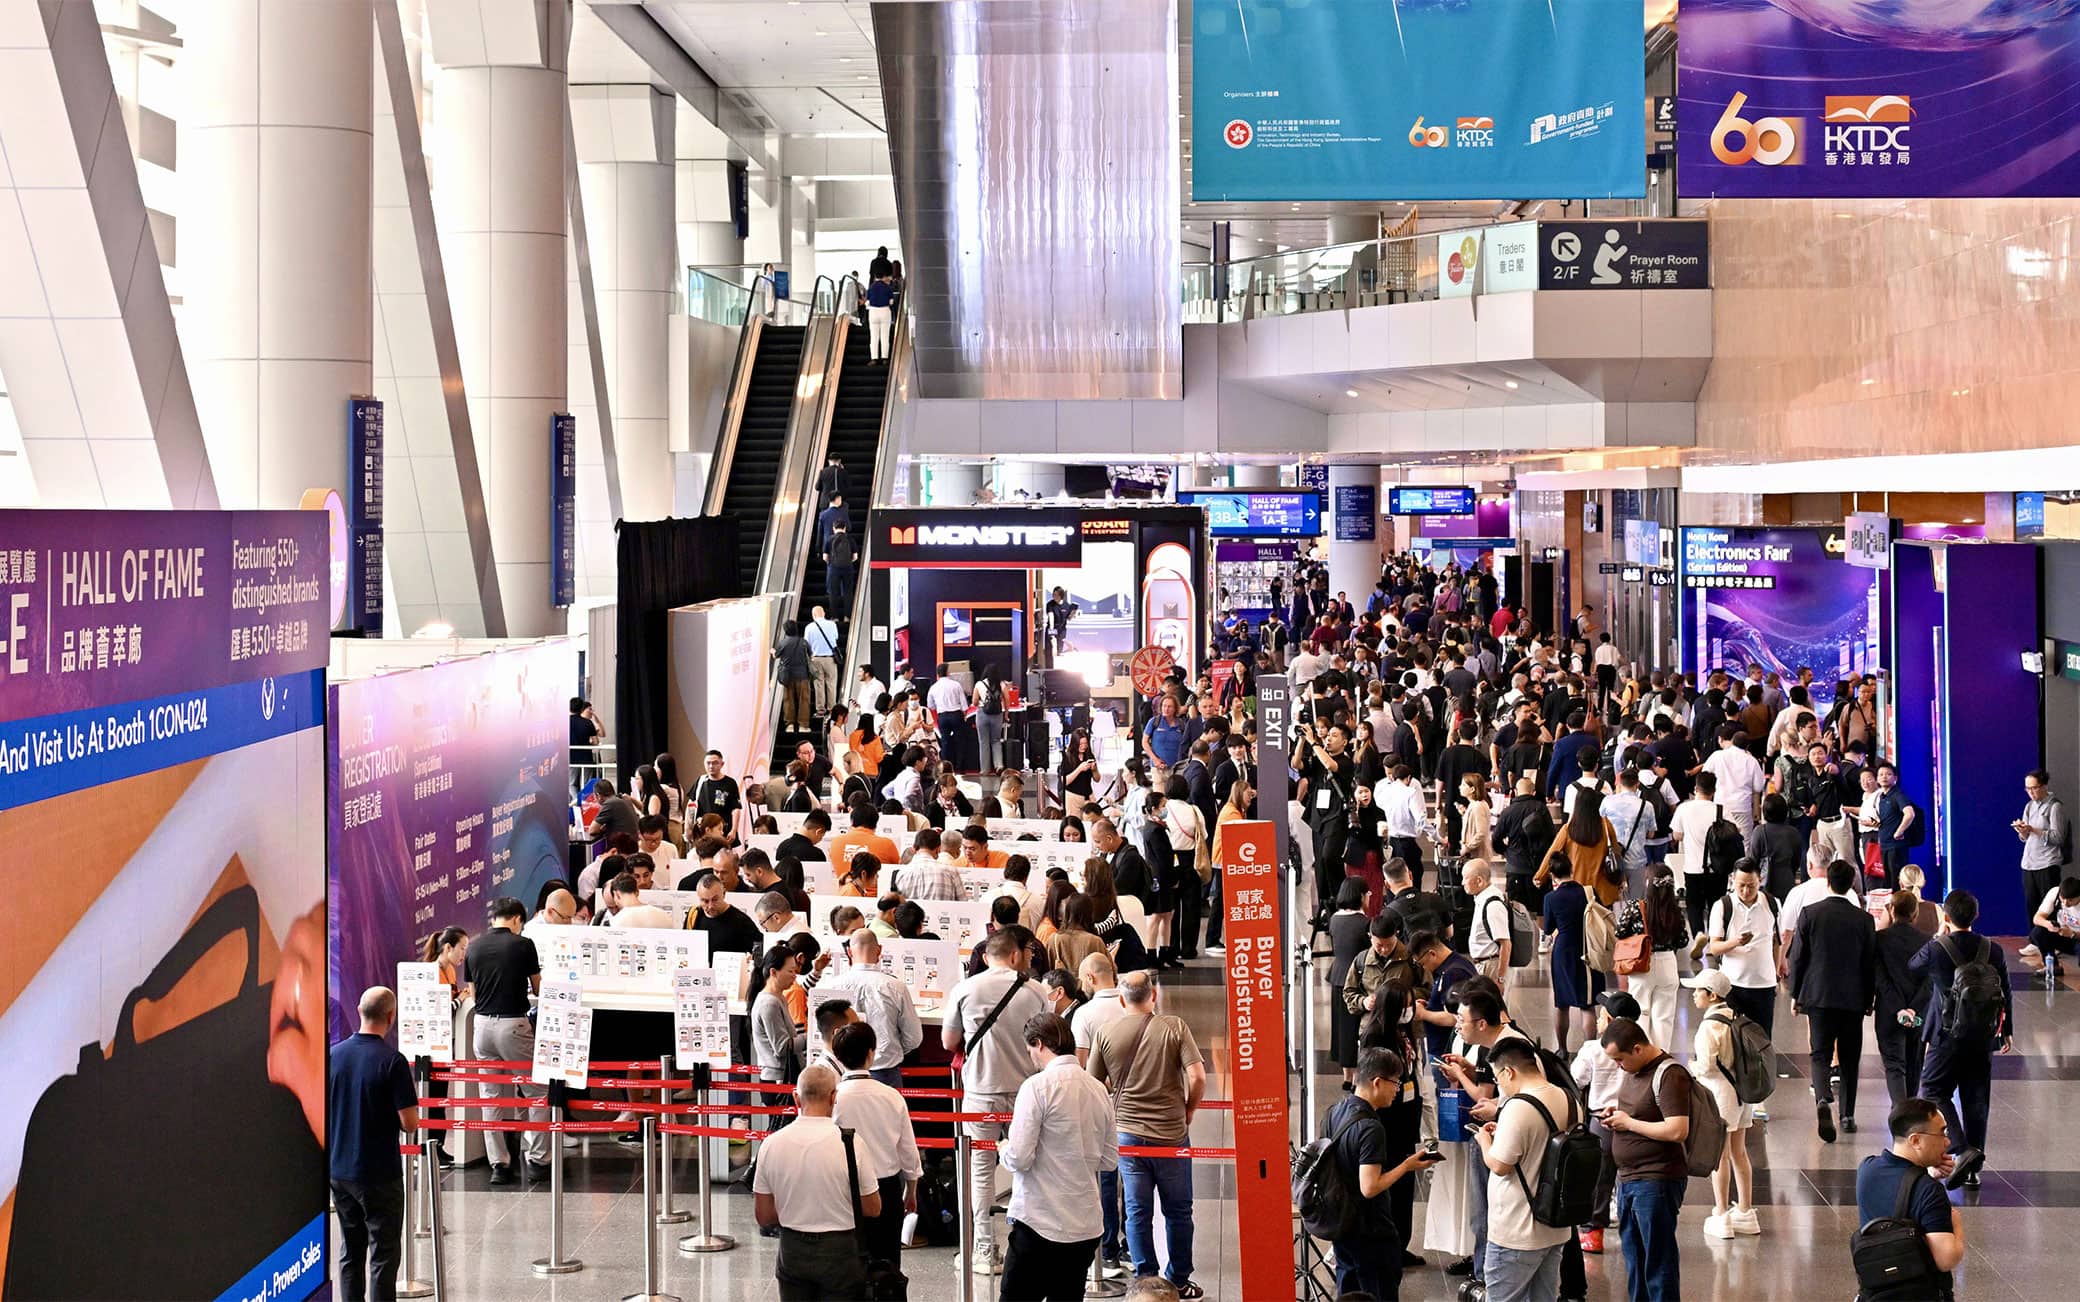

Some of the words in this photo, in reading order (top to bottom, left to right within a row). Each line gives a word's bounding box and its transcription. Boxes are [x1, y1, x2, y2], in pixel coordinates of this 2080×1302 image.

[1457, 129, 1494, 141] HKTDC
[1710, 90, 1795, 166] 60
[1824, 126, 1910, 151] HKTDC
[1824, 152, 1910, 165] 香港貿發局
[1497, 242, 1526, 256] Traders
[1630, 255, 1665, 266] Prayer
[1667, 255, 1698, 265] Room
[1554, 266, 1580, 280] 2/F
[1630, 270, 1678, 284] 祈禱室
[1262, 516, 1288, 525] 1A-E
[917, 526, 1067, 546] MONSTER
[1687, 533, 1707, 544] Hong
[1708, 533, 1729, 544] Kong
[232, 538, 277, 574] Featuring
[277, 538, 300, 568] 550+
[1258, 548, 1277, 556] HALL
[1686, 544, 1762, 560] Electronics
[1764, 545, 1790, 560] Fair
[62, 550, 116, 606] HALL
[121, 549, 149, 604] OF
[154, 547, 204, 601] FAME
[1687, 563, 1716, 574] (Spring
[1716, 562, 1748, 573] Edition)
[232, 578, 292, 616] distinguished
[292, 574, 320, 602] brands
[61, 623, 143, 674] 品牌薈萃廊
[1262, 688, 1284, 701] 出口
[0, 732, 30, 775] And
[32, 728, 63, 767] Visit
[67, 724, 85, 761] Us
[87, 720, 104, 756] At
[107, 714, 146, 748] Booth
[148, 698, 208, 742] 1CON-024
[1265, 707, 1282, 750] EXIT
[344, 744, 407, 790] REGISTRATION
[344, 790, 382, 832] 買家登記處
[1227, 863, 1272, 876] Badge
[1236, 889, 1264, 905] 買家
[1230, 904, 1273, 922] 登記處
[1254, 936, 1274, 1000] Buyer
[1231, 937, 1257, 1070] Registration
[273, 1271, 300, 1298] Proven
[302, 1241, 321, 1273] Sales
